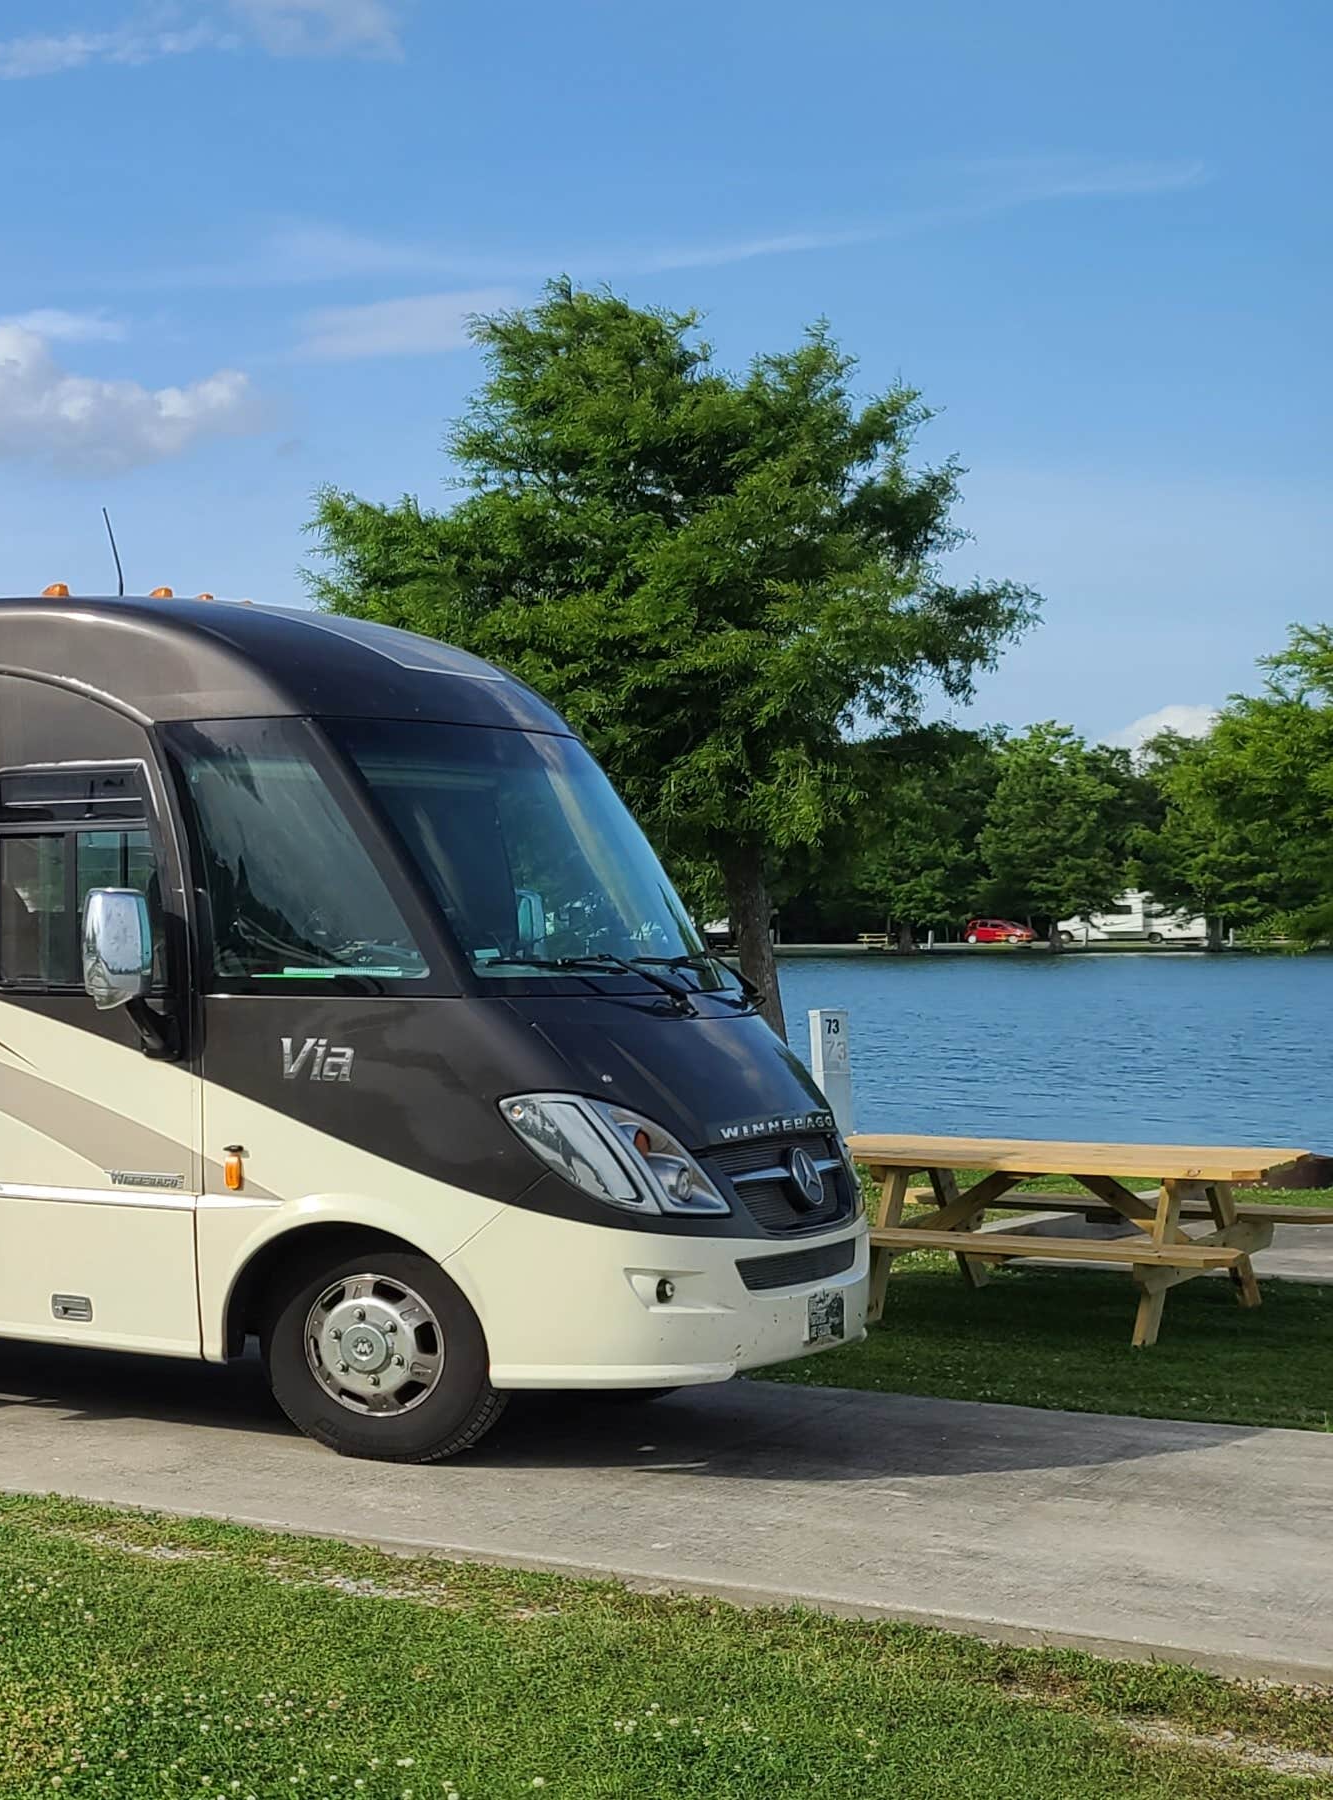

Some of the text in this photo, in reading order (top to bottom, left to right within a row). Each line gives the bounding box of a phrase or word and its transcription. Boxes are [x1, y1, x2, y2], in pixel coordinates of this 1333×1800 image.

[825, 1019, 840, 1034] 73
[280, 1037, 354, 1082] Via
[825, 1041, 847, 1061] 73
[720, 1116, 833, 1140] WINNEBAGO
